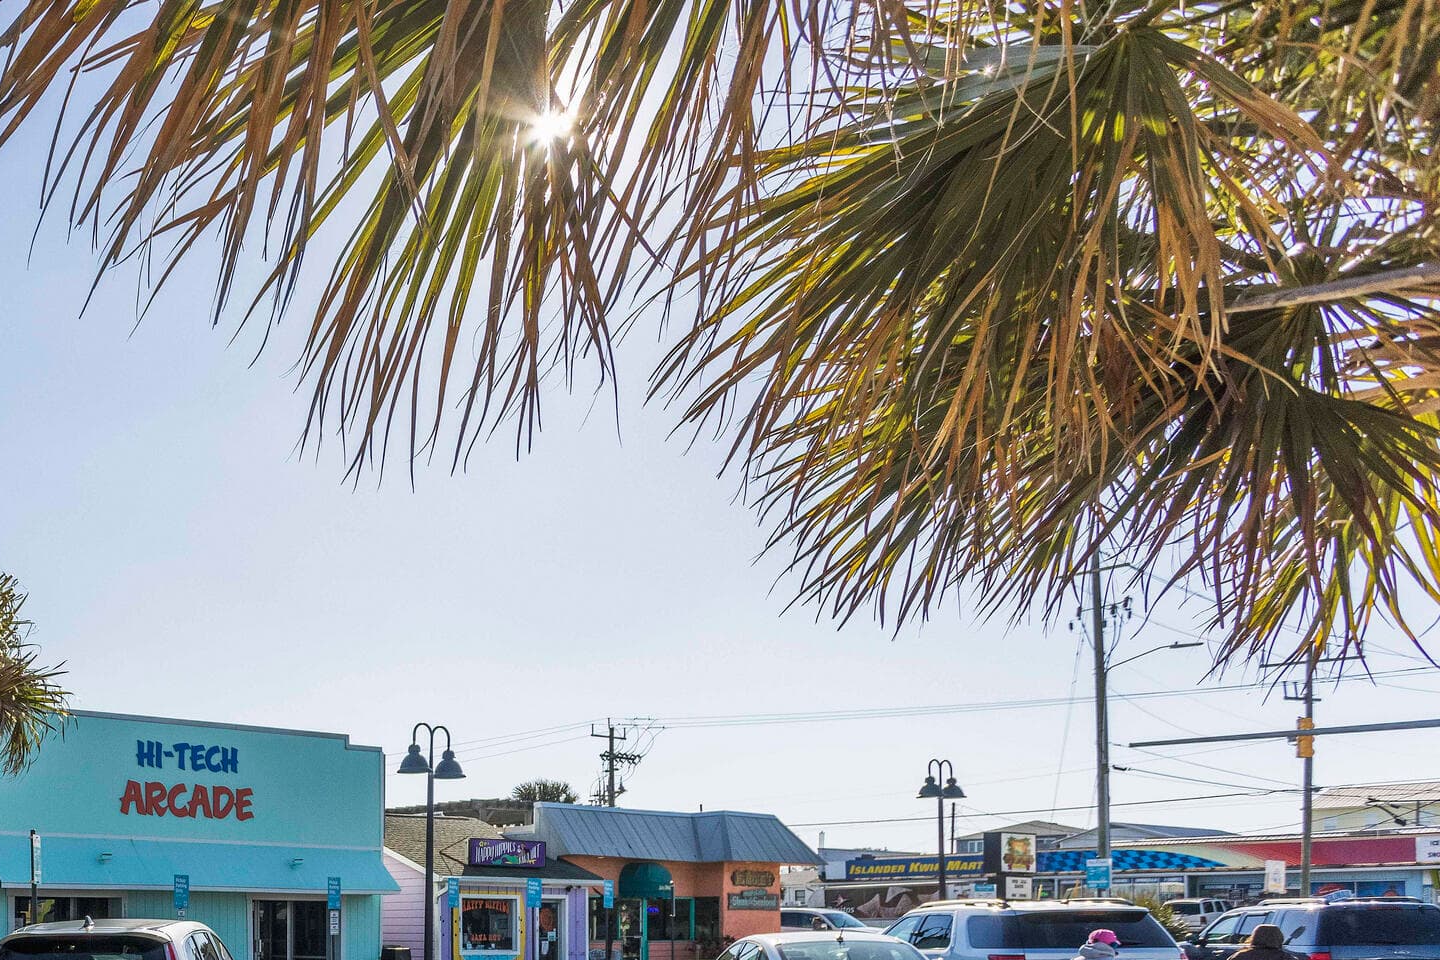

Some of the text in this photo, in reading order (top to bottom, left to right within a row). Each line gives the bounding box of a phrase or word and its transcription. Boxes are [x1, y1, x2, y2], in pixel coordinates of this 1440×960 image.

[136, 739, 239, 774] HI-TECH
[119, 779, 255, 821] ARCADE
[946, 860, 984, 871] MART
